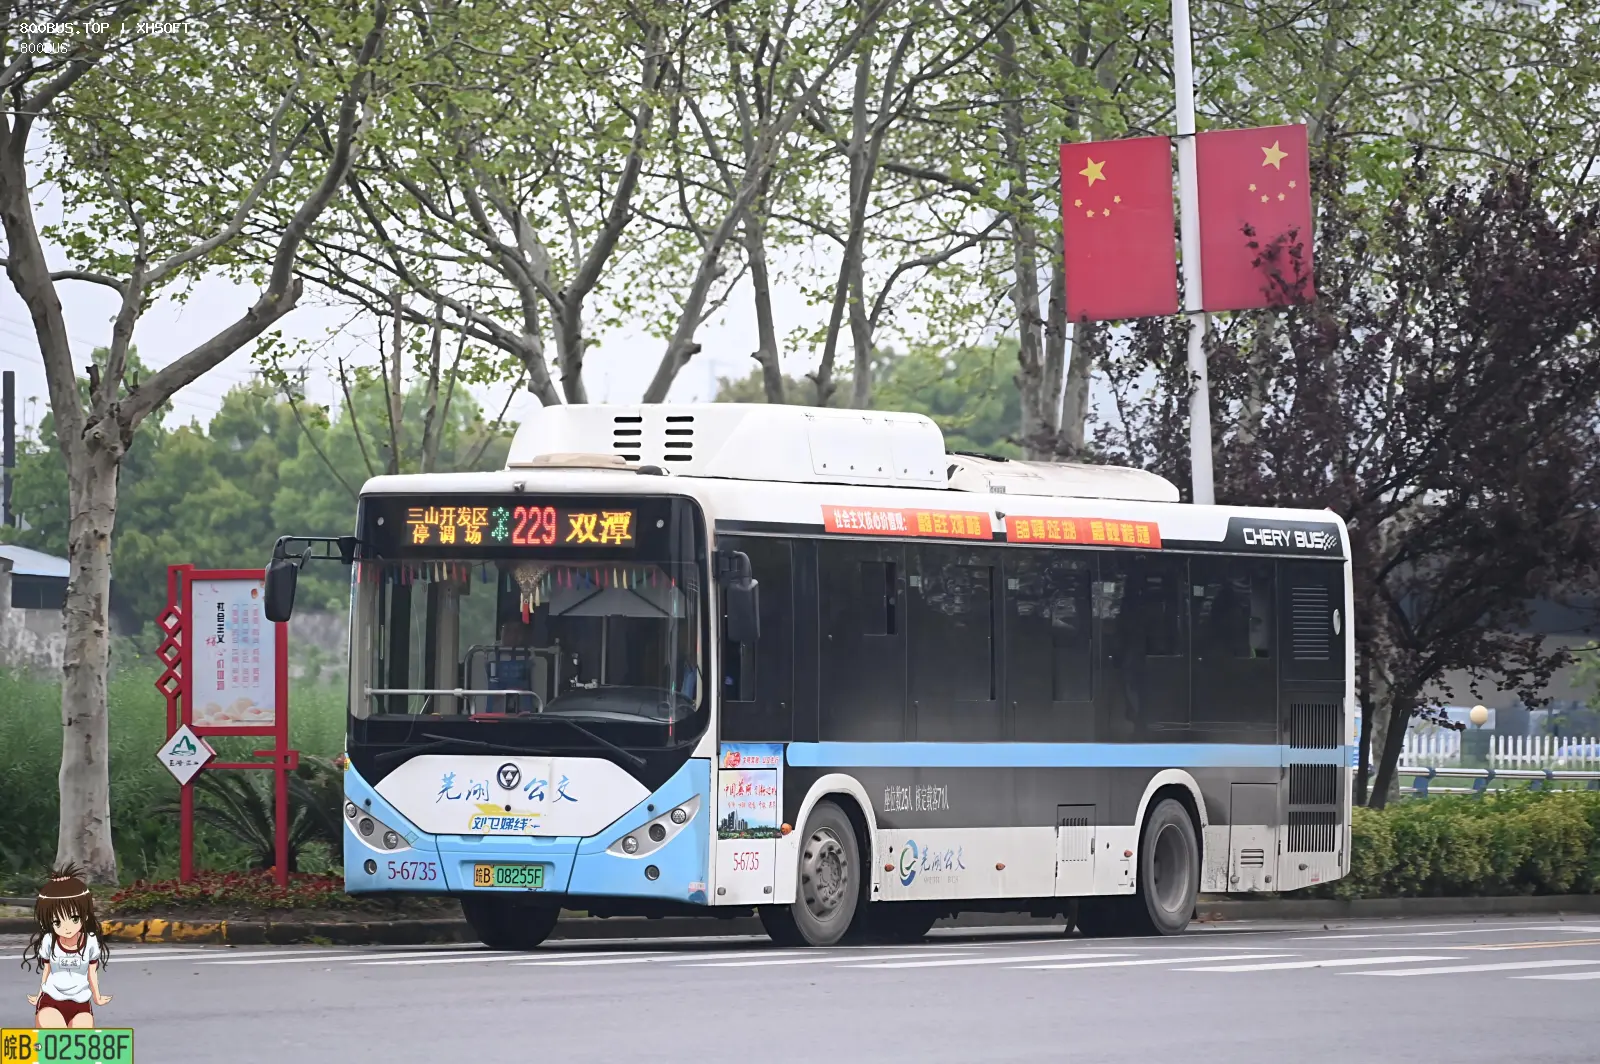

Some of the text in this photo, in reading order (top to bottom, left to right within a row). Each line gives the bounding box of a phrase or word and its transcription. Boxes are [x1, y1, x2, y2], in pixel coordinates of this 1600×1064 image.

[407, 507, 489, 526] 三山开发区
[512, 506, 556, 544] 229
[566, 512, 631, 543] 双潭
[1243, 528, 1325, 549] CHERY BUS
[435, 771, 579, 804] 芜湖 公交
[387, 860, 437, 881] 5-6735
[733, 851, 759, 870] 5-6735
